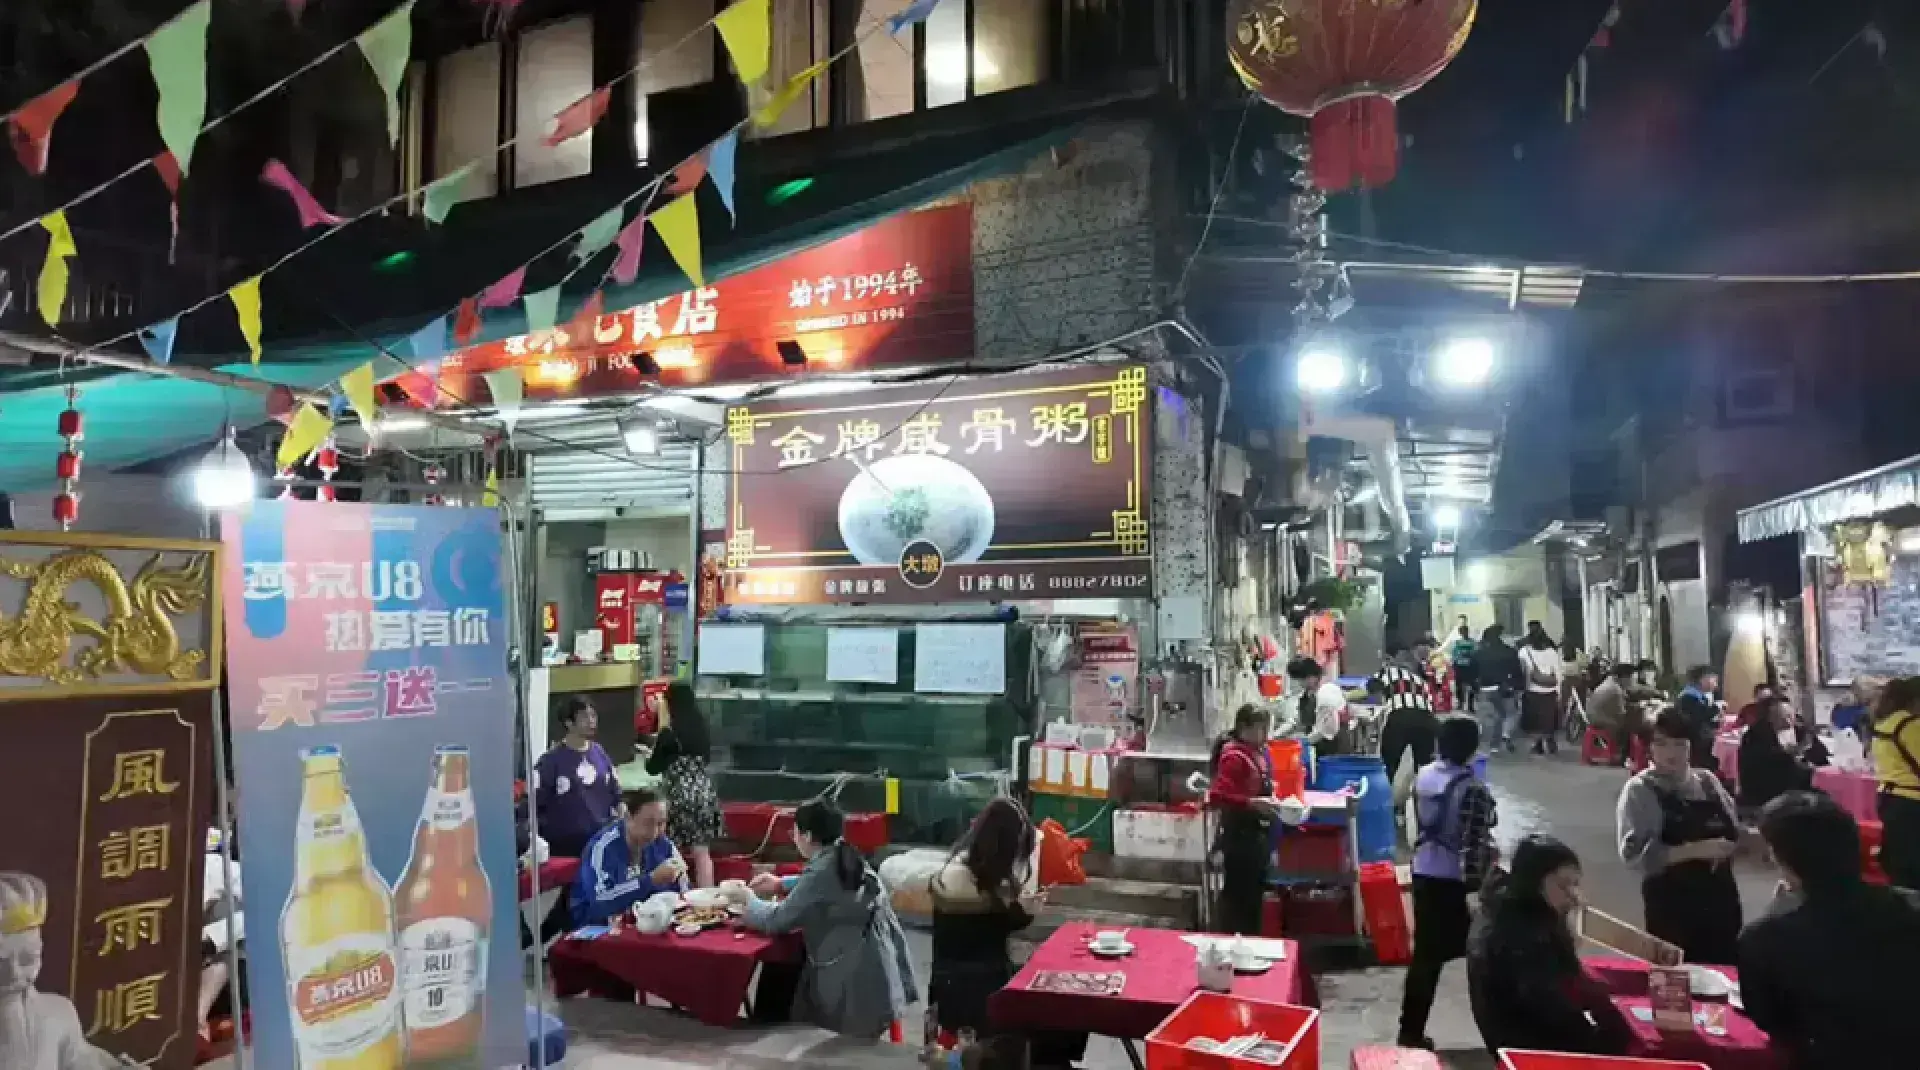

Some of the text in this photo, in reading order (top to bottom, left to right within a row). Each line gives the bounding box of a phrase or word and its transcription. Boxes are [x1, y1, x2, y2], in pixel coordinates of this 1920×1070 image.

[788, 261, 924, 308] 始于1994年
[771, 402, 1088, 469] 金牌咸骨粥
[324, 607, 490, 651] 热爱有你
[256, 666, 493, 731] 买三送一
[85, 749, 181, 1037] 風調雨順
